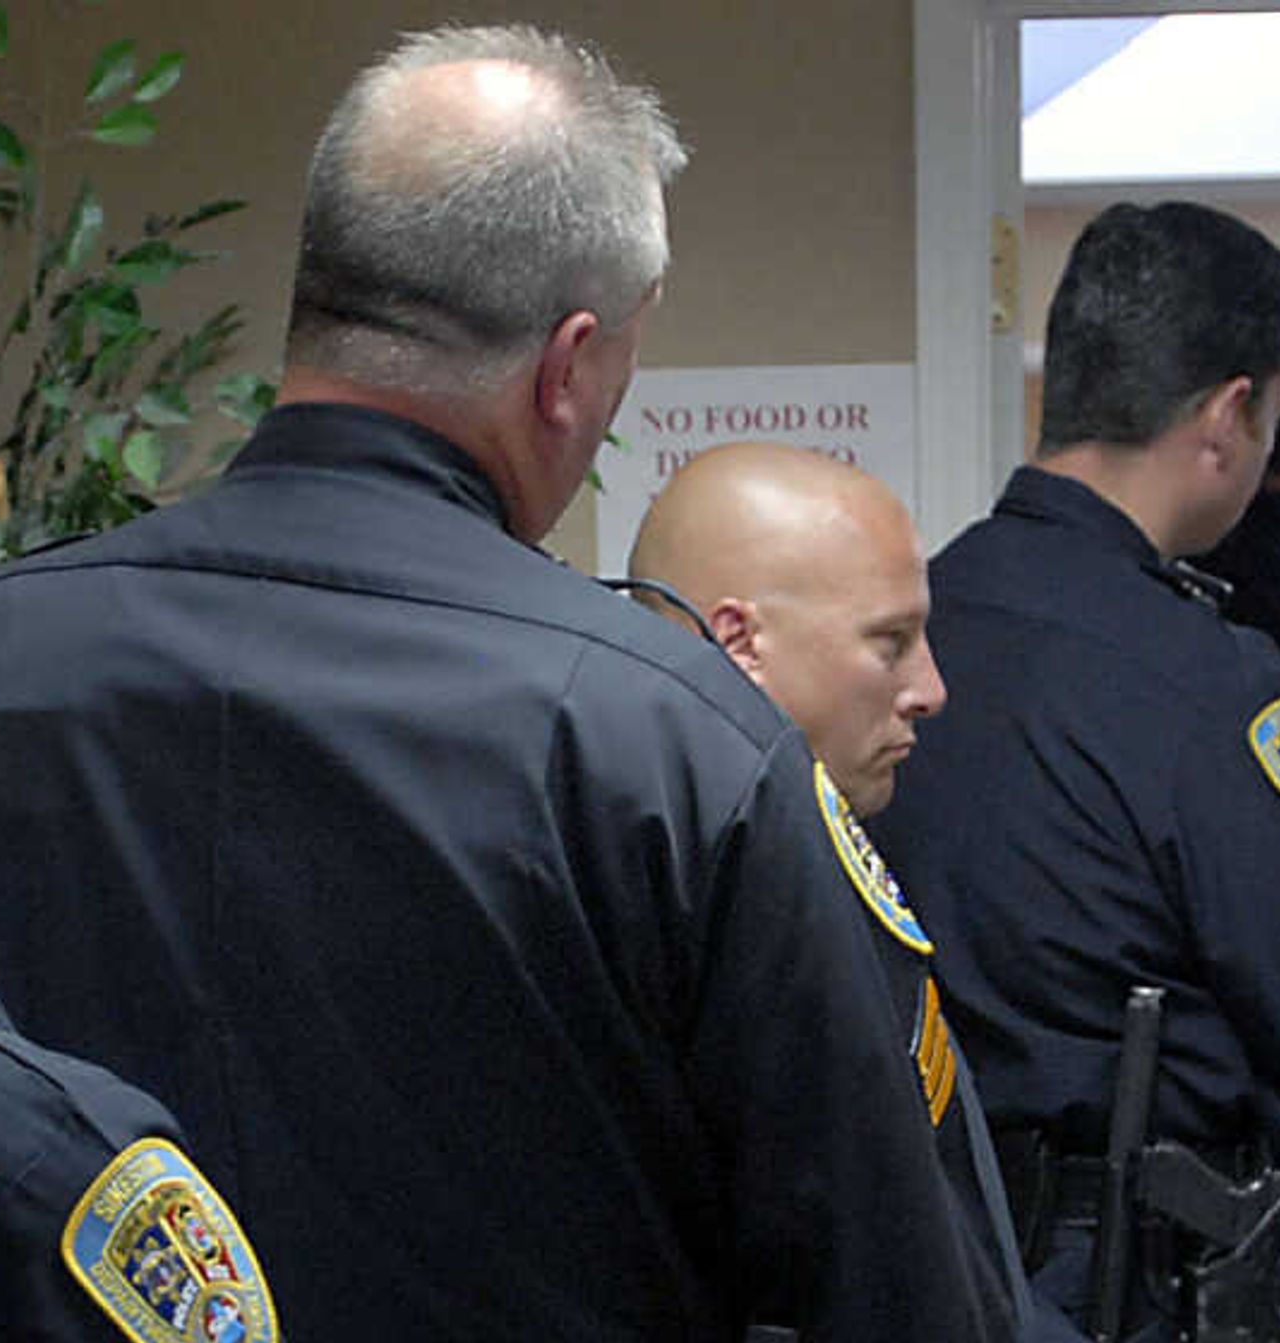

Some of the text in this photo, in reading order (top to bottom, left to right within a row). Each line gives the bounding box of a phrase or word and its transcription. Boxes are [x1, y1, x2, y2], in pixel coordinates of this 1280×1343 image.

[641, 402, 870, 433] NO FOOD OR
